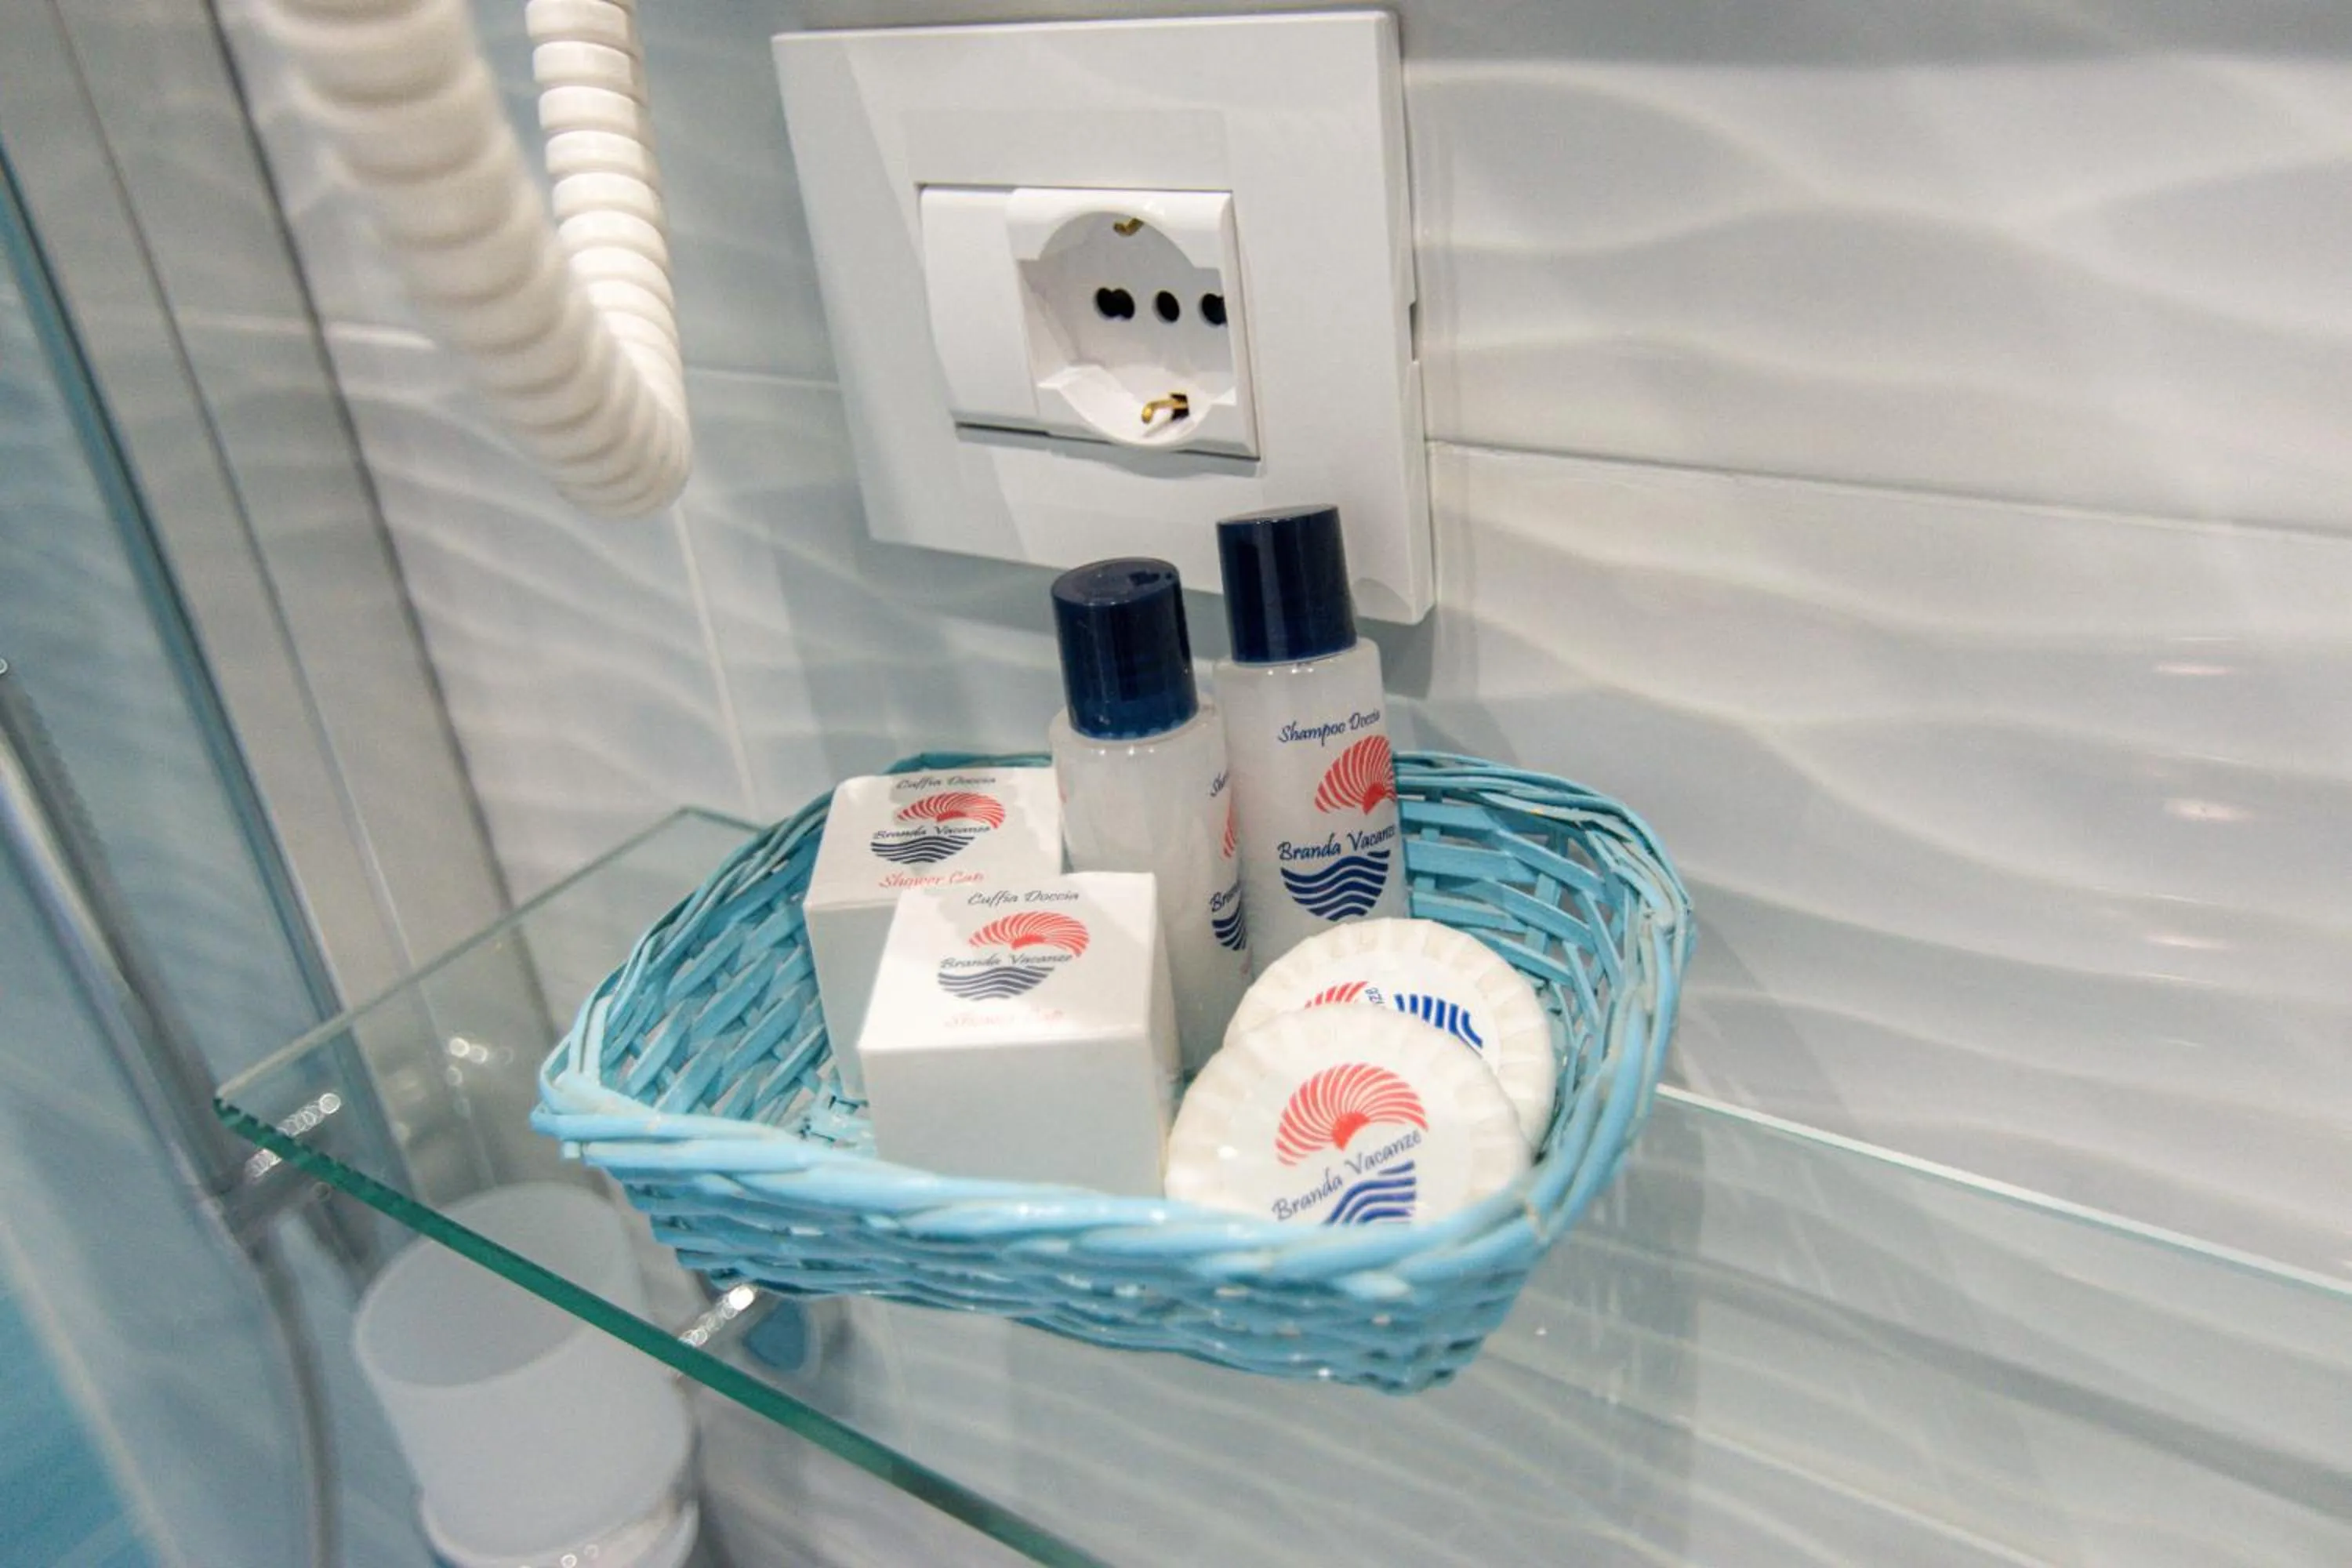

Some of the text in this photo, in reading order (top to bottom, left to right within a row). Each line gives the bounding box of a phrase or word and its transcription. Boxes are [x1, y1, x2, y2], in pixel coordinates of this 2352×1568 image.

[1278, 720, 1345, 746] Shampoo
[1276, 825, 1396, 861] Branda Vacanz
[967, 890, 1018, 907] Cuffia
[1272, 1129, 1422, 1221] Branda Vacanze
